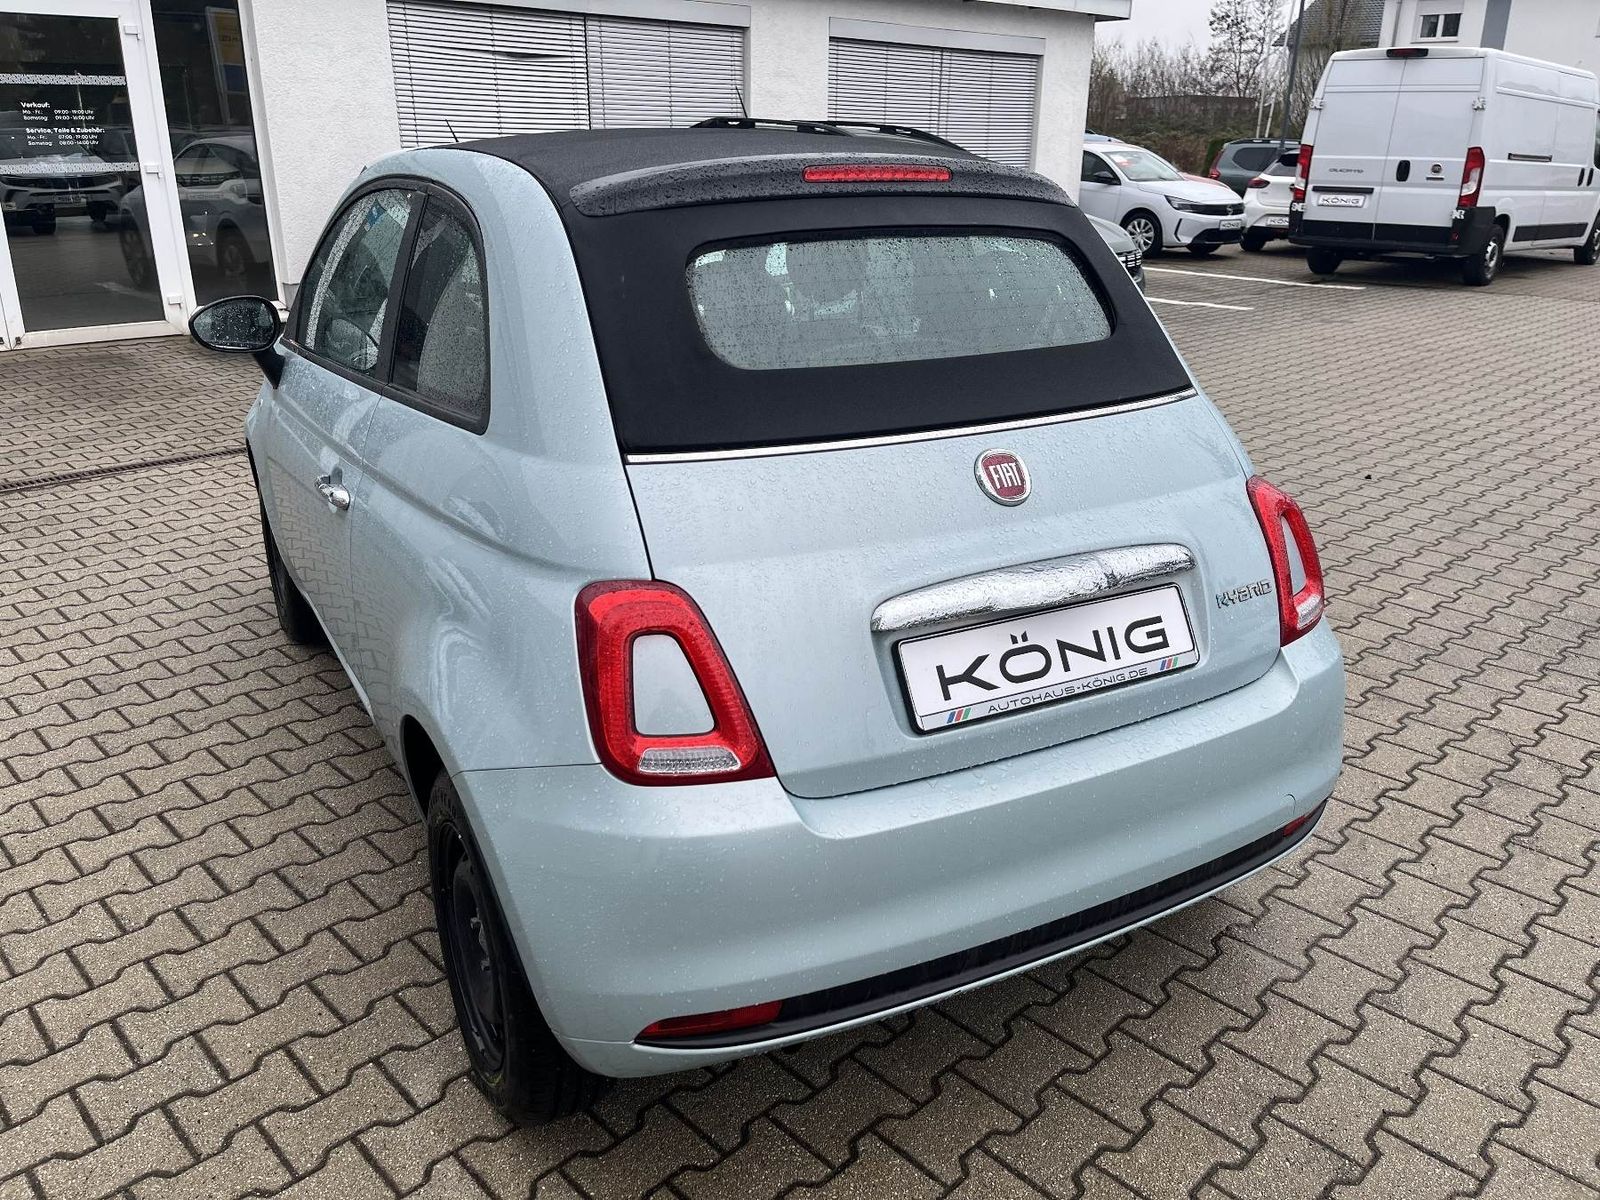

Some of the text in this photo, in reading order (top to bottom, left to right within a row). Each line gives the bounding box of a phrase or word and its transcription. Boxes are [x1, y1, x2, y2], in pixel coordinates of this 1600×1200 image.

[988, 462, 1022, 489] FIAT
[1216, 579, 1273, 609] HYBRID
[936, 615, 1170, 701] KÖNIG
[988, 667, 1149, 714] AUTOHAUS-KÖNIG.DE
